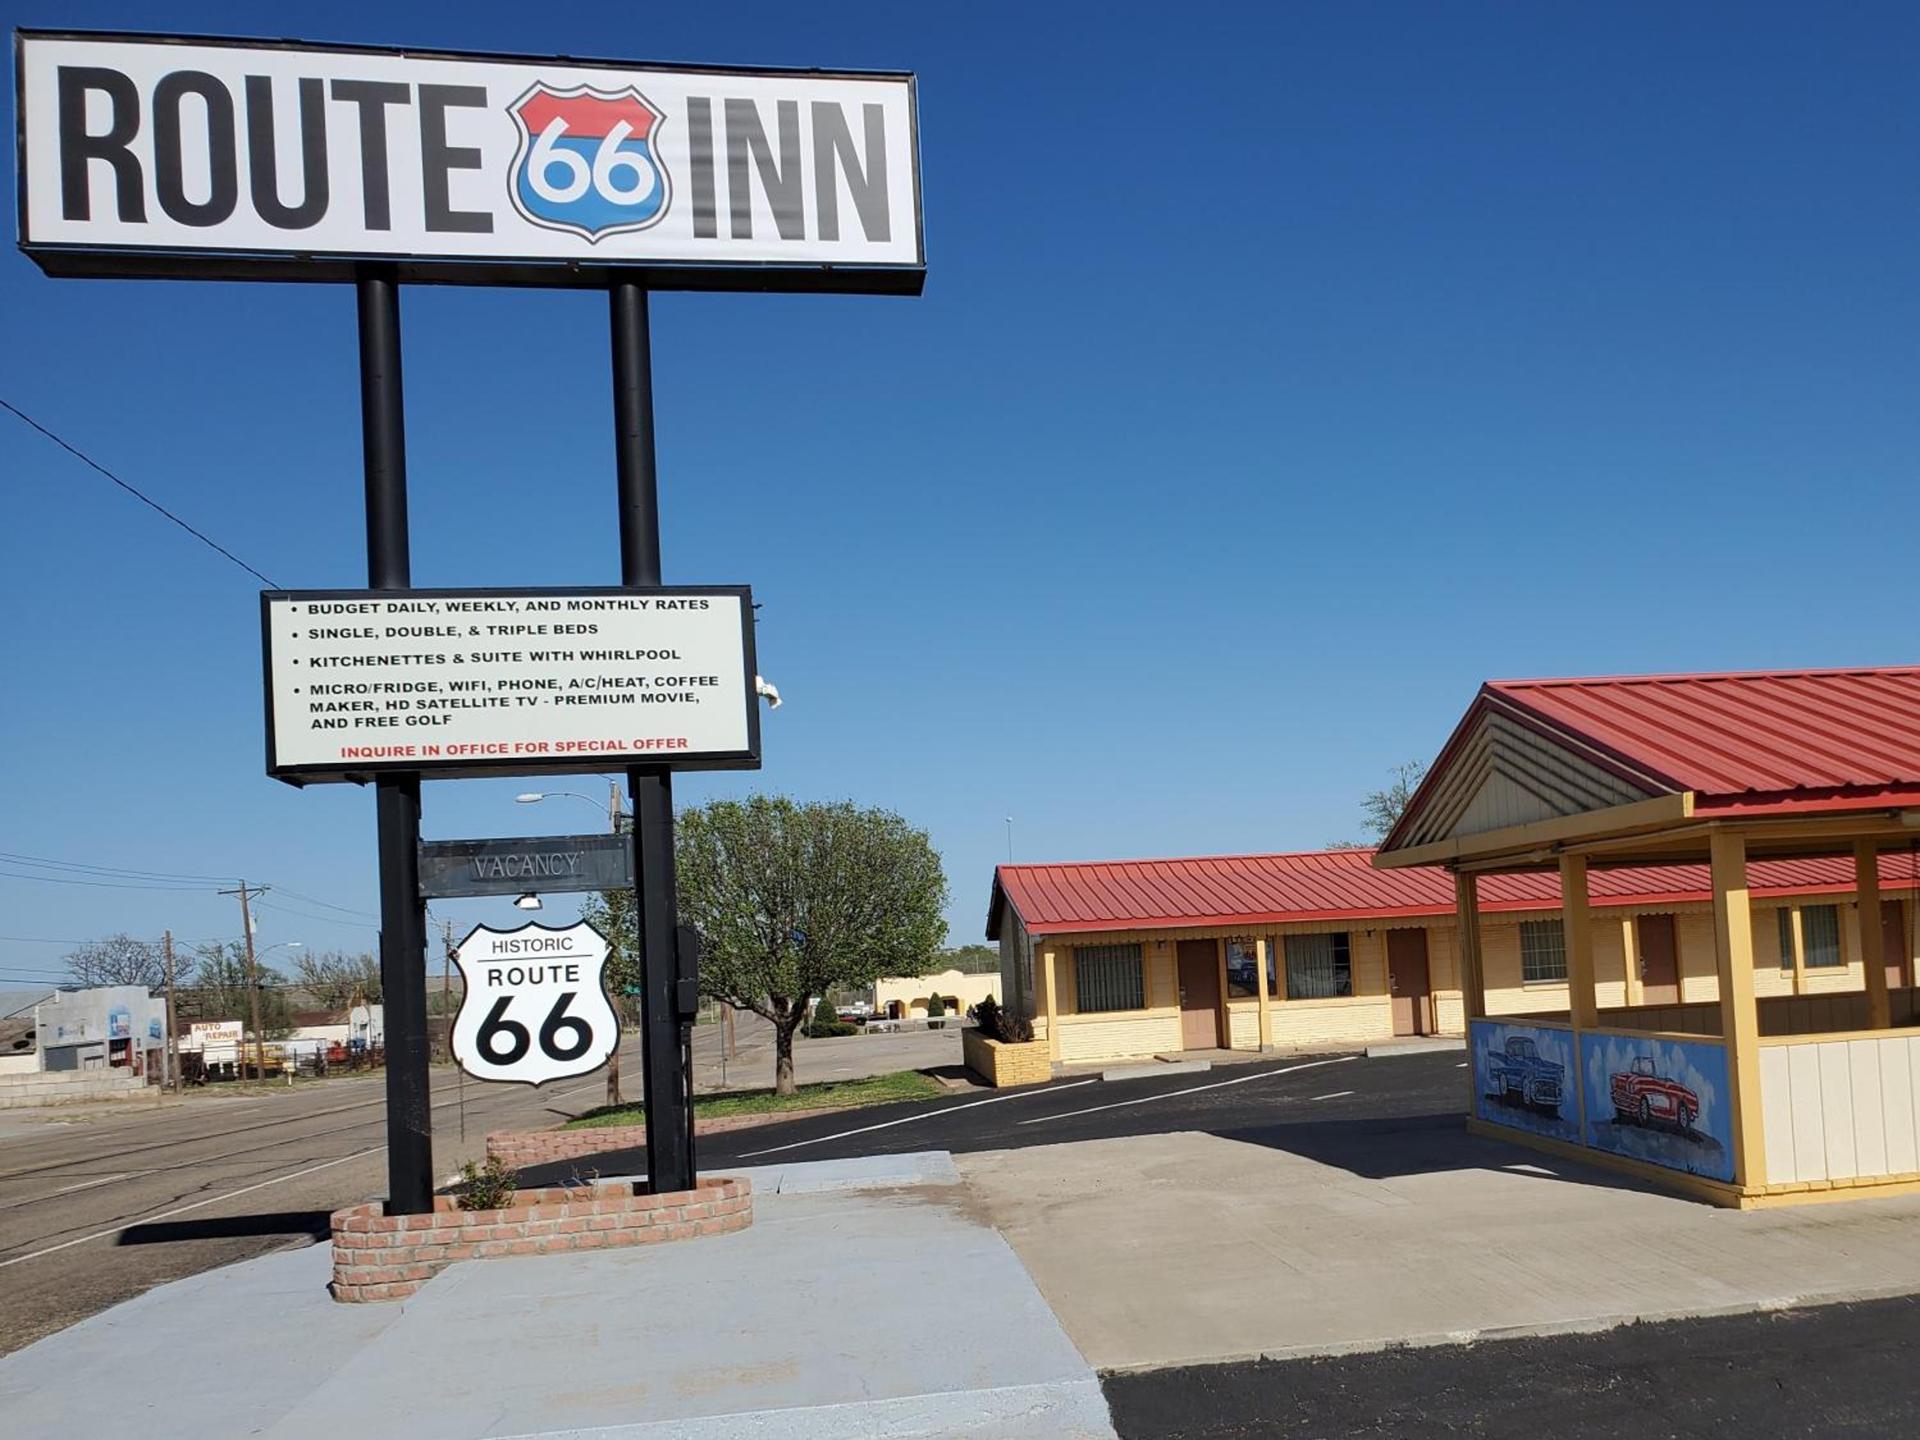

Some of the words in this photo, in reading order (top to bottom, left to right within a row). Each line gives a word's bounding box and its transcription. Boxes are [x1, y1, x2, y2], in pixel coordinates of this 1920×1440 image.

[57, 65, 494, 234] ROUTE
[527, 116, 656, 205] 66
[687, 96, 891, 242] INN
[308, 603, 380, 615] BUDGET
[387, 603, 440, 615] DAILY,
[446, 602, 520, 614] WEEKLY,
[526, 601, 561, 612] AND
[567, 600, 649, 611] MONTHLY
[656, 600, 710, 610] RATES
[309, 628, 380, 640] SINGLE,
[386, 626, 462, 638] DOUBLE,
[468, 626, 481, 636] &
[487, 625, 548, 636] TRIPLE
[554, 624, 599, 635] BEDS
[310, 654, 446, 668] KITCHENETTES
[453, 654, 465, 664] &
[471, 652, 522, 664] SUITE
[529, 651, 574, 662] WITH
[579, 650, 681, 662] WHIRLPOOL
[310, 682, 444, 697] MICRO/FRIDGE,
[448, 681, 492, 693] WIFI,
[498, 679, 563, 692] PHONE,
[568, 676, 650, 692] A/C/HEAT,
[655, 677, 719, 688] COFFEE
[310, 701, 380, 714] MAKER,
[386, 700, 410, 711] HD
[416, 697, 510, 710] SATELLITE
[515, 697, 538, 707] TV
[555, 694, 635, 706] PREMIUM
[640, 693, 700, 704] MOVIE,
[311, 718, 349, 730] AND
[355, 717, 400, 728] FREE
[406, 715, 452, 727] GOLF
[341, 746, 416, 758] INQUIRE
[423, 745, 440, 756] IN
[446, 744, 509, 756] OFFICE
[515, 743, 549, 754] FOR
[555, 741, 628, 753] SPECIAL
[633, 739, 688, 750] OFFER
[474, 852, 578, 878] VACANCY
[492, 937, 574, 954] HISTORIC
[487, 964, 580, 987] ROUTE
[195, 1023, 221, 1032] AUTO
[206, 1031, 238, 1040] REPAIR
[475, 992, 594, 1067] 66
